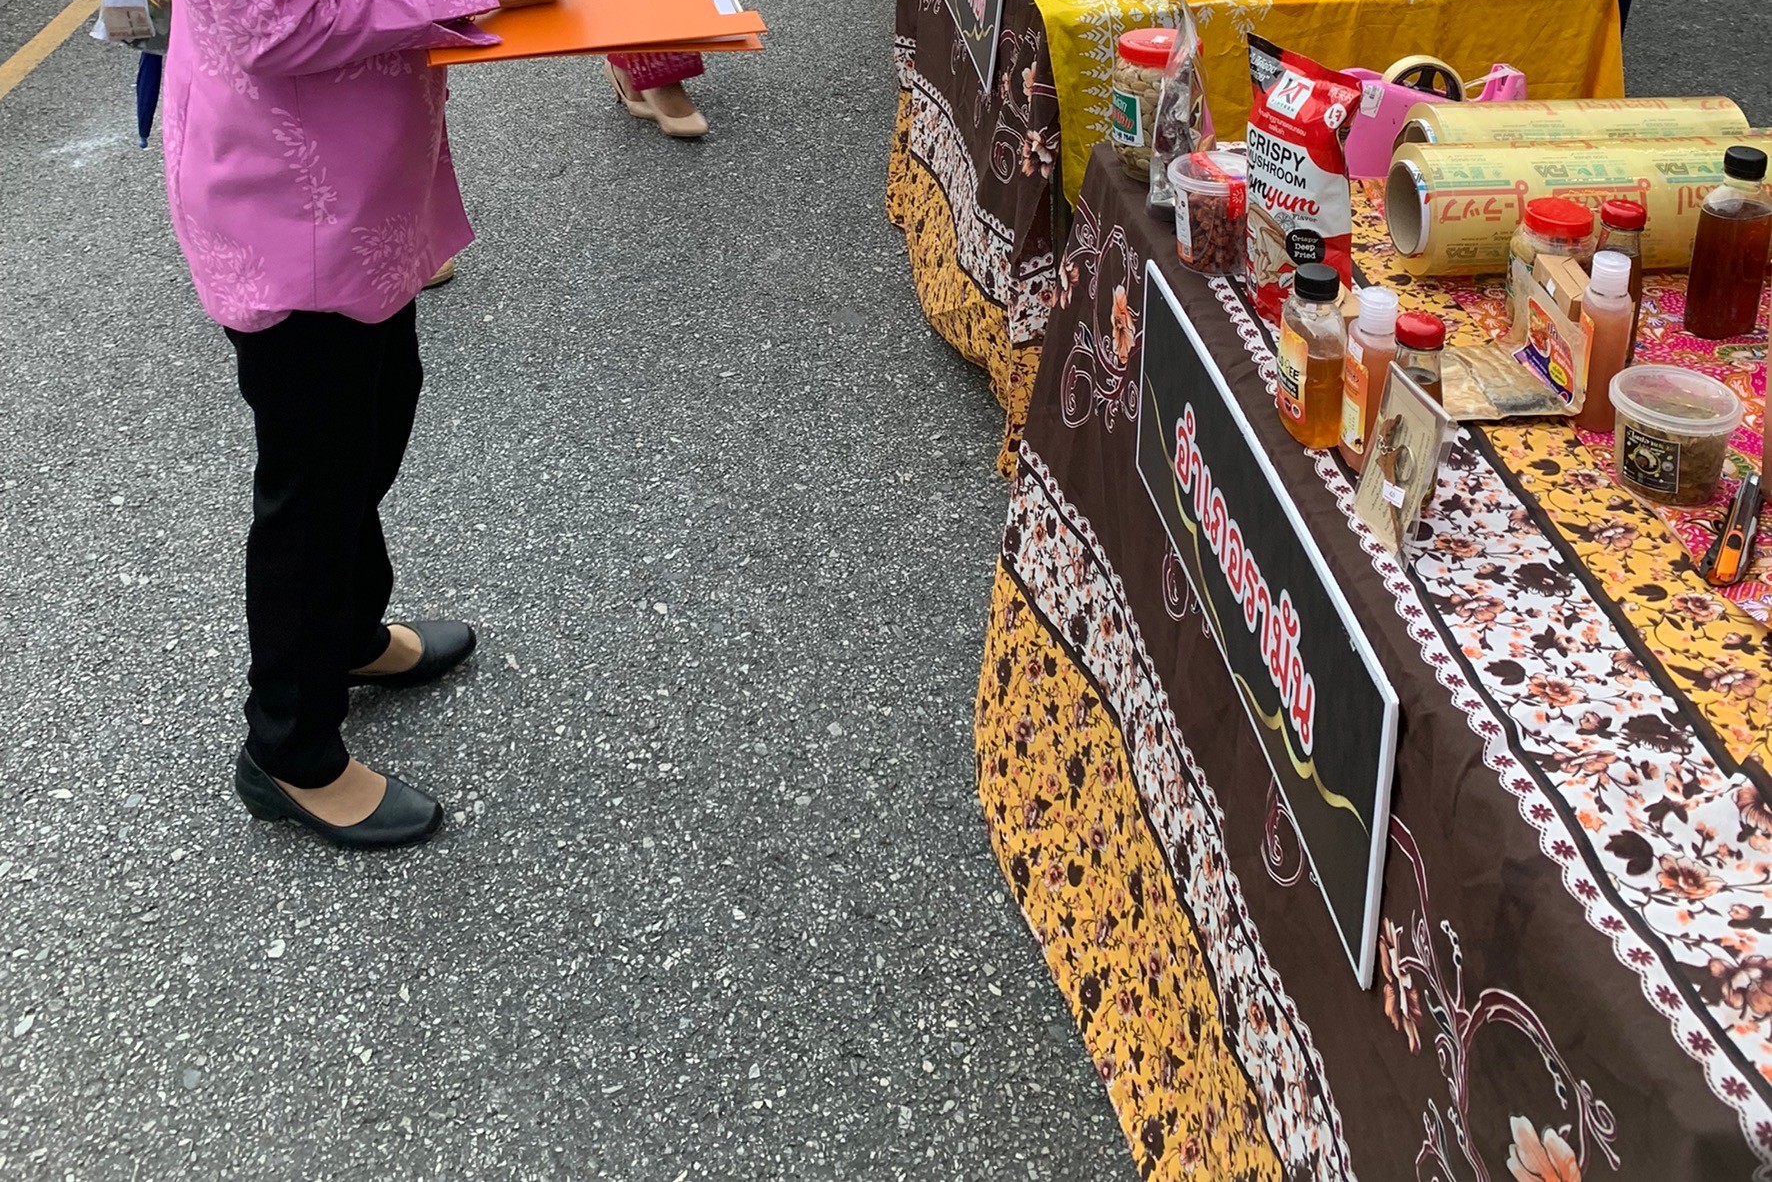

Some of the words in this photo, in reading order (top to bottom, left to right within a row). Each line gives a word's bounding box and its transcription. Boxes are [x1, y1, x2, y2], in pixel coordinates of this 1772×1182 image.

[1249, 129, 1306, 172] CRISPY
[1533, 164, 1569, 178] FDA
[1291, 234, 1319, 244] Crispy
[1294, 243, 1316, 252] Deep
[1446, 246, 1478, 259] FDA
[1294, 251, 1317, 260] Fried
[1175, 403, 1316, 753] อำเภอรามัน
